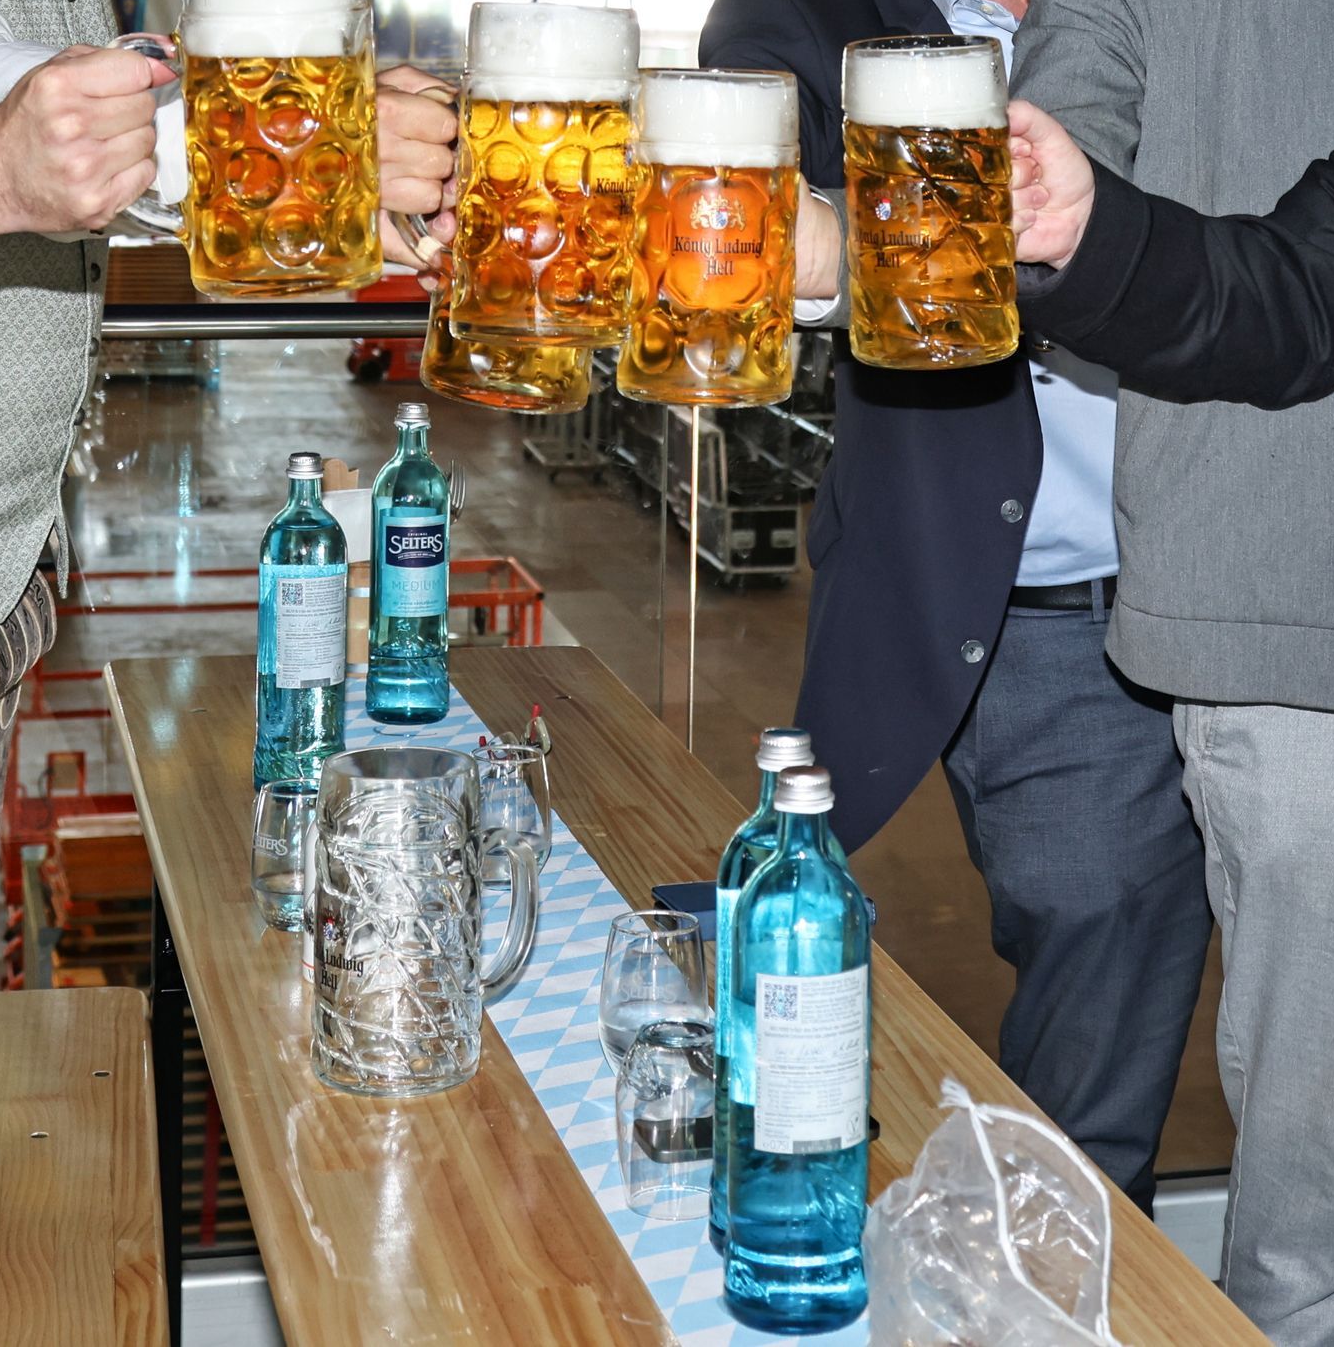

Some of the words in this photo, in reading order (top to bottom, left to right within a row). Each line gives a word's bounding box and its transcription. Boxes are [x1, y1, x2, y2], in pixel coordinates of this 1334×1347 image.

[672, 236, 712, 258] König
[711, 237, 763, 258] Ludwig
[703, 259, 734, 280] Hell
[388, 533, 444, 554] SELTERS
[391, 579, 441, 592] MEDIUM
[256, 835, 288, 856] ELTERS
[324, 949, 364, 977] Ludwig
